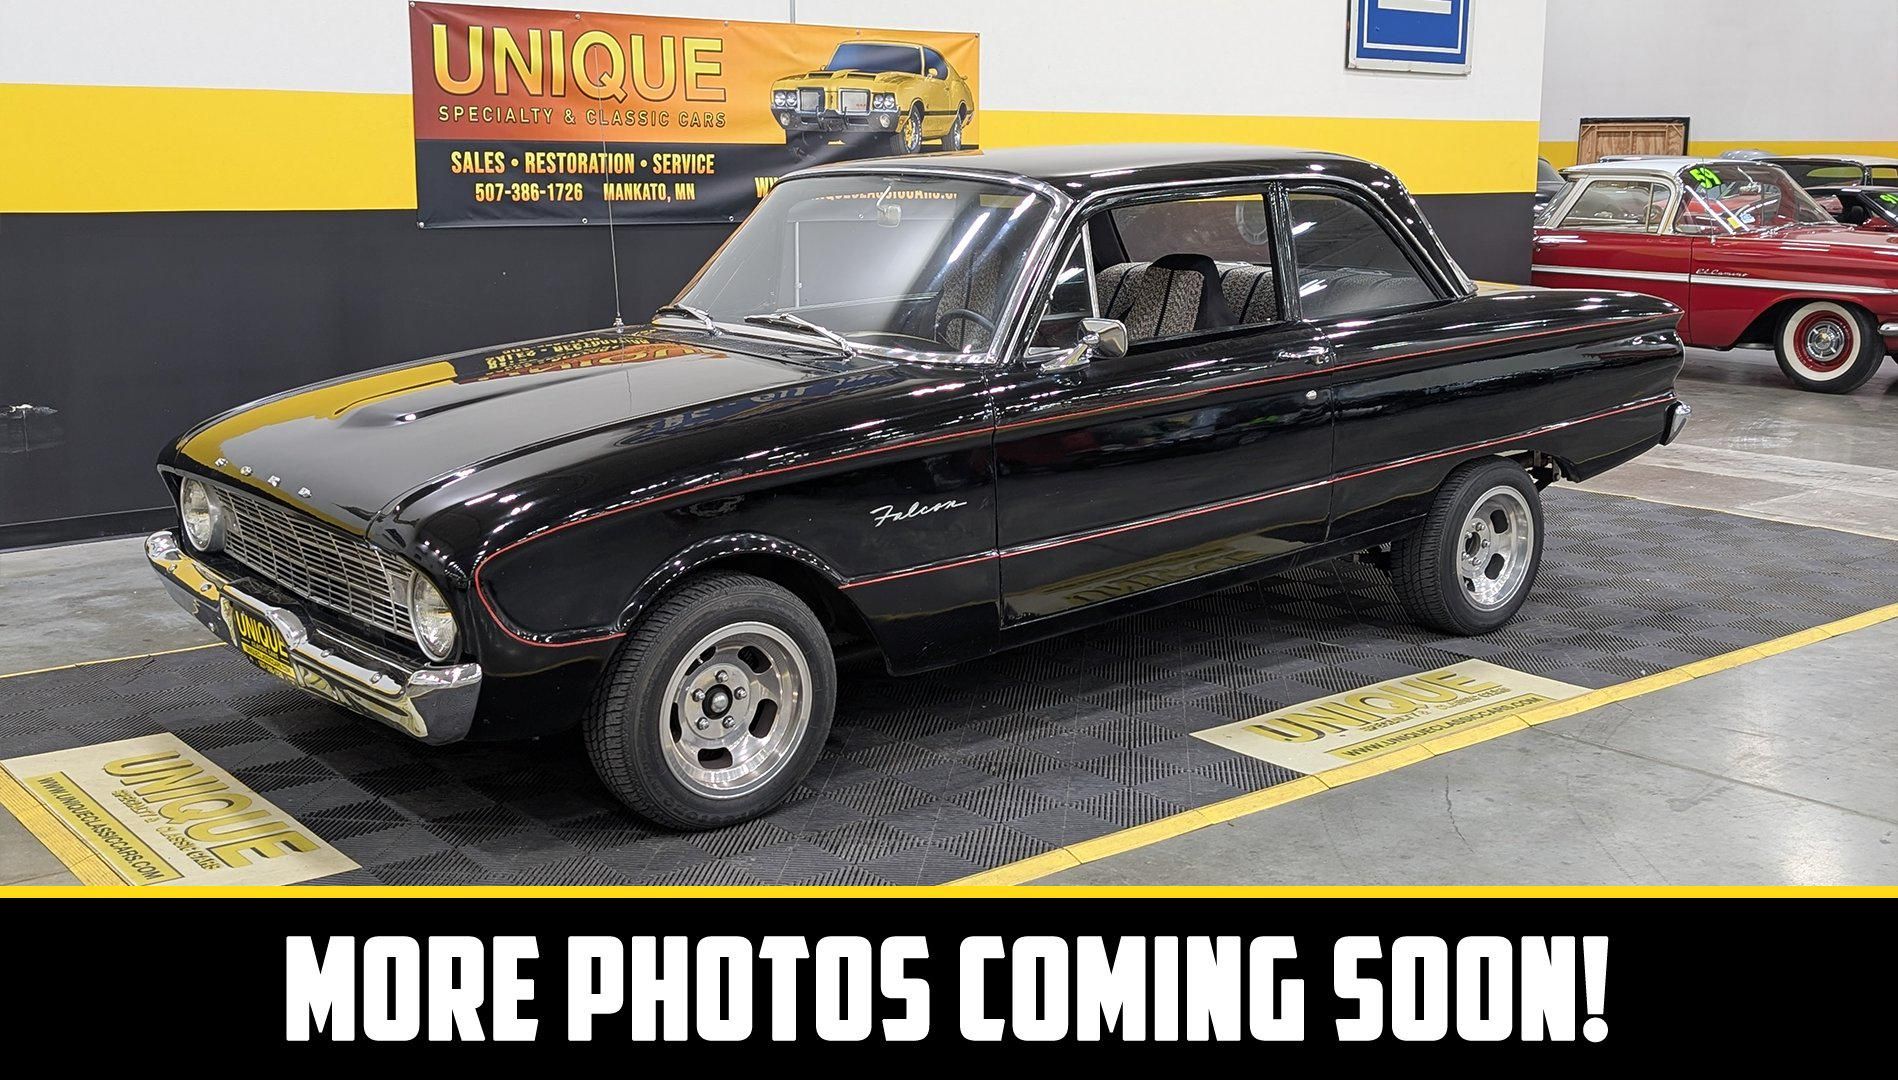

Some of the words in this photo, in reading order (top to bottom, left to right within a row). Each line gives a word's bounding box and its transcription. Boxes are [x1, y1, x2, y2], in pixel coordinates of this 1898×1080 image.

[431, 22, 727, 104] UNIQUE
[438, 105, 553, 125] SPECIALTY
[564, 109, 576, 124] &
[586, 109, 669, 127] CLASSIC
[679, 112, 727, 128] CARS
[450, 150, 506, 174] SALES
[525, 151, 635, 175] RESTORATION
[652, 153, 716, 175] SERVICE
[1689, 167, 1722, 189] 59
[475, 182, 584, 203] 507-386-1726
[603, 182, 672, 203] MANKATO,
[674, 182, 696, 201] MN
[869, 500, 968, 528] Falcon
[235, 610, 289, 659] UNIQUE
[1242, 670, 1502, 744] UNIQUE
[1343, 695, 1544, 758] WWW.UNIQUECLASSICCARS.COM
[38, 776, 165, 880] WWW.UNIQUECLASSICCARS.COM
[103, 750, 321, 870] UNIQUE
